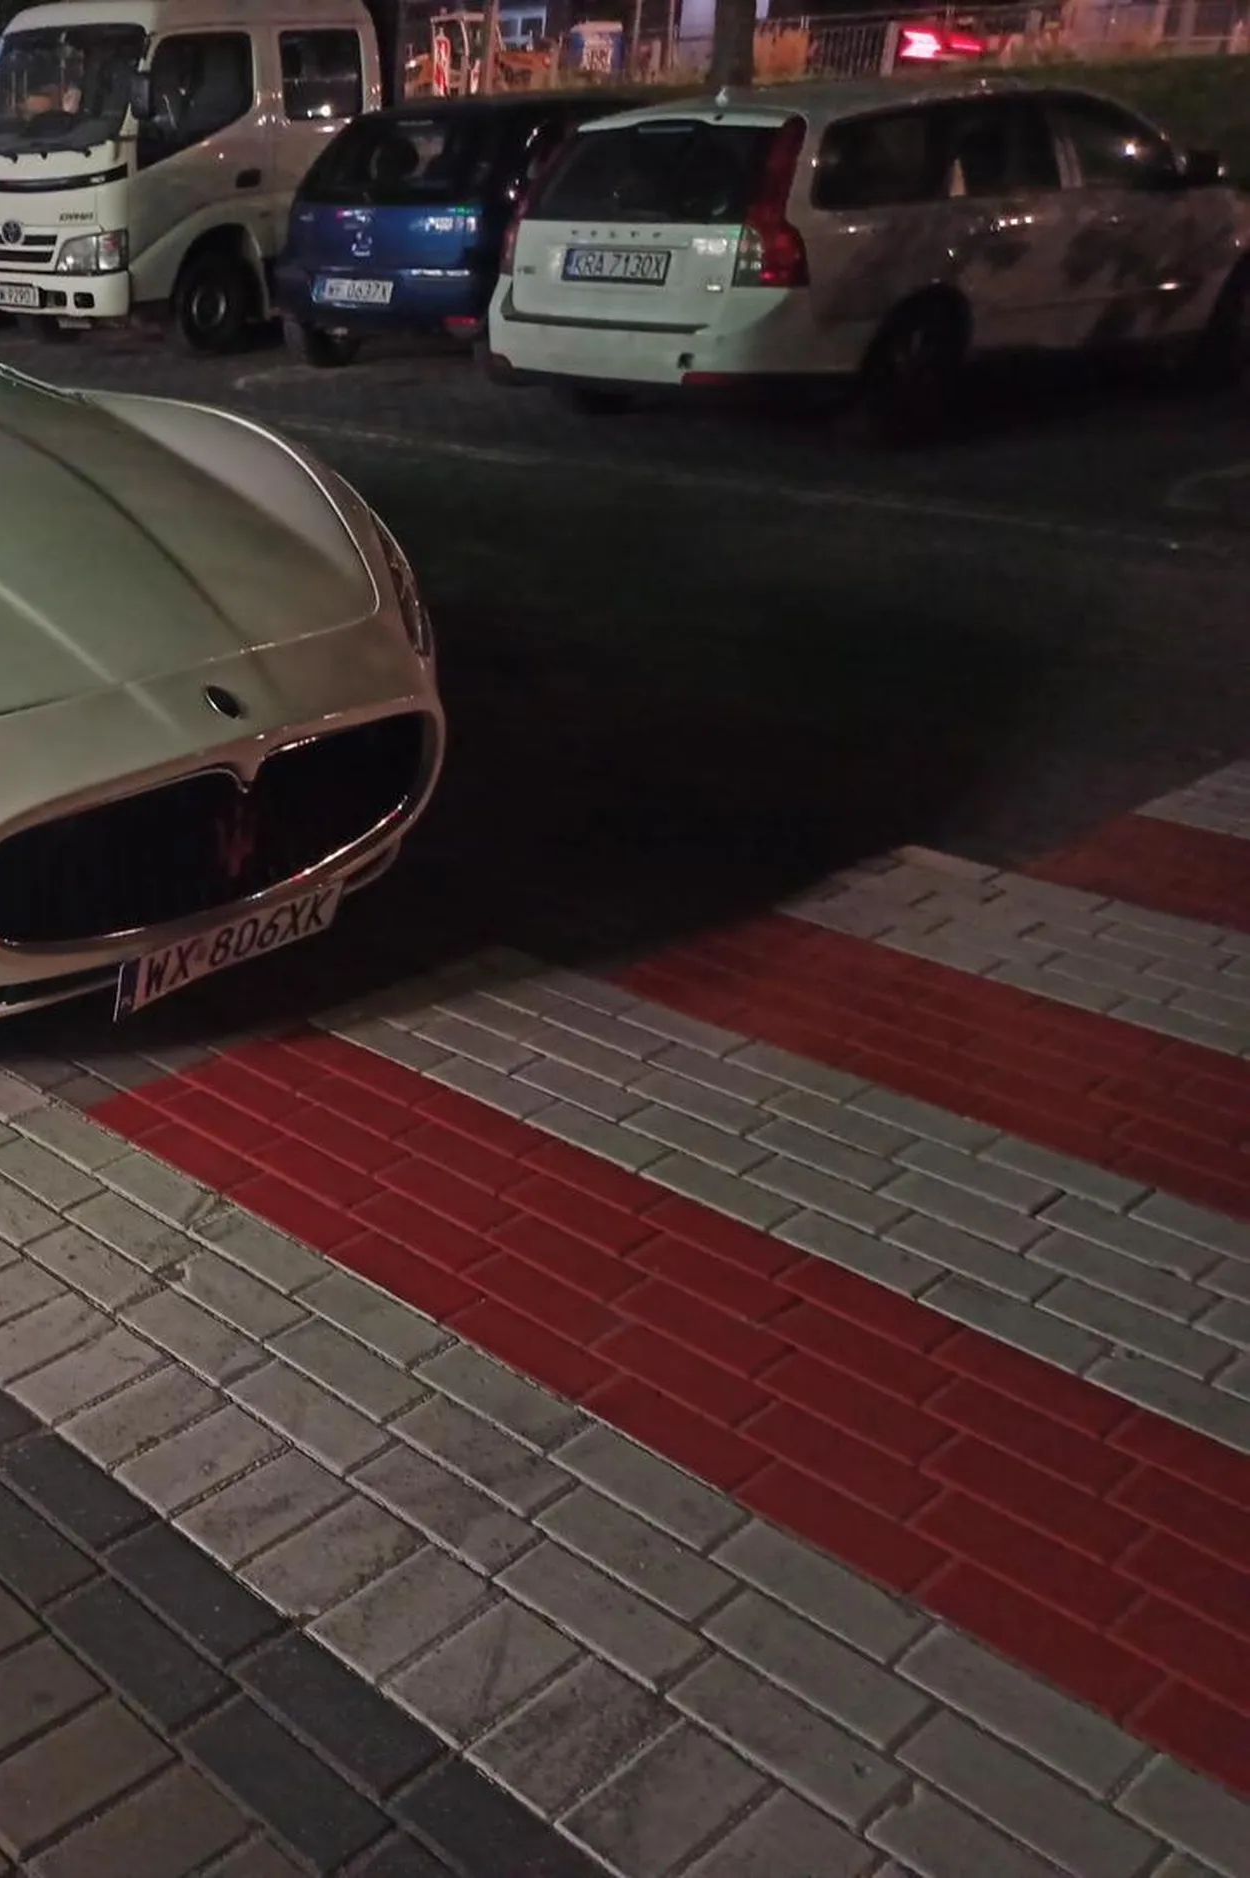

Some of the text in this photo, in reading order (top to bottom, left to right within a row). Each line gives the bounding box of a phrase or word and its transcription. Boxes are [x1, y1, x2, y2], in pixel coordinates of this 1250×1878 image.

[575, 252, 665, 278] KRA 7130X
[144, 888, 332, 998] WX 806XK
